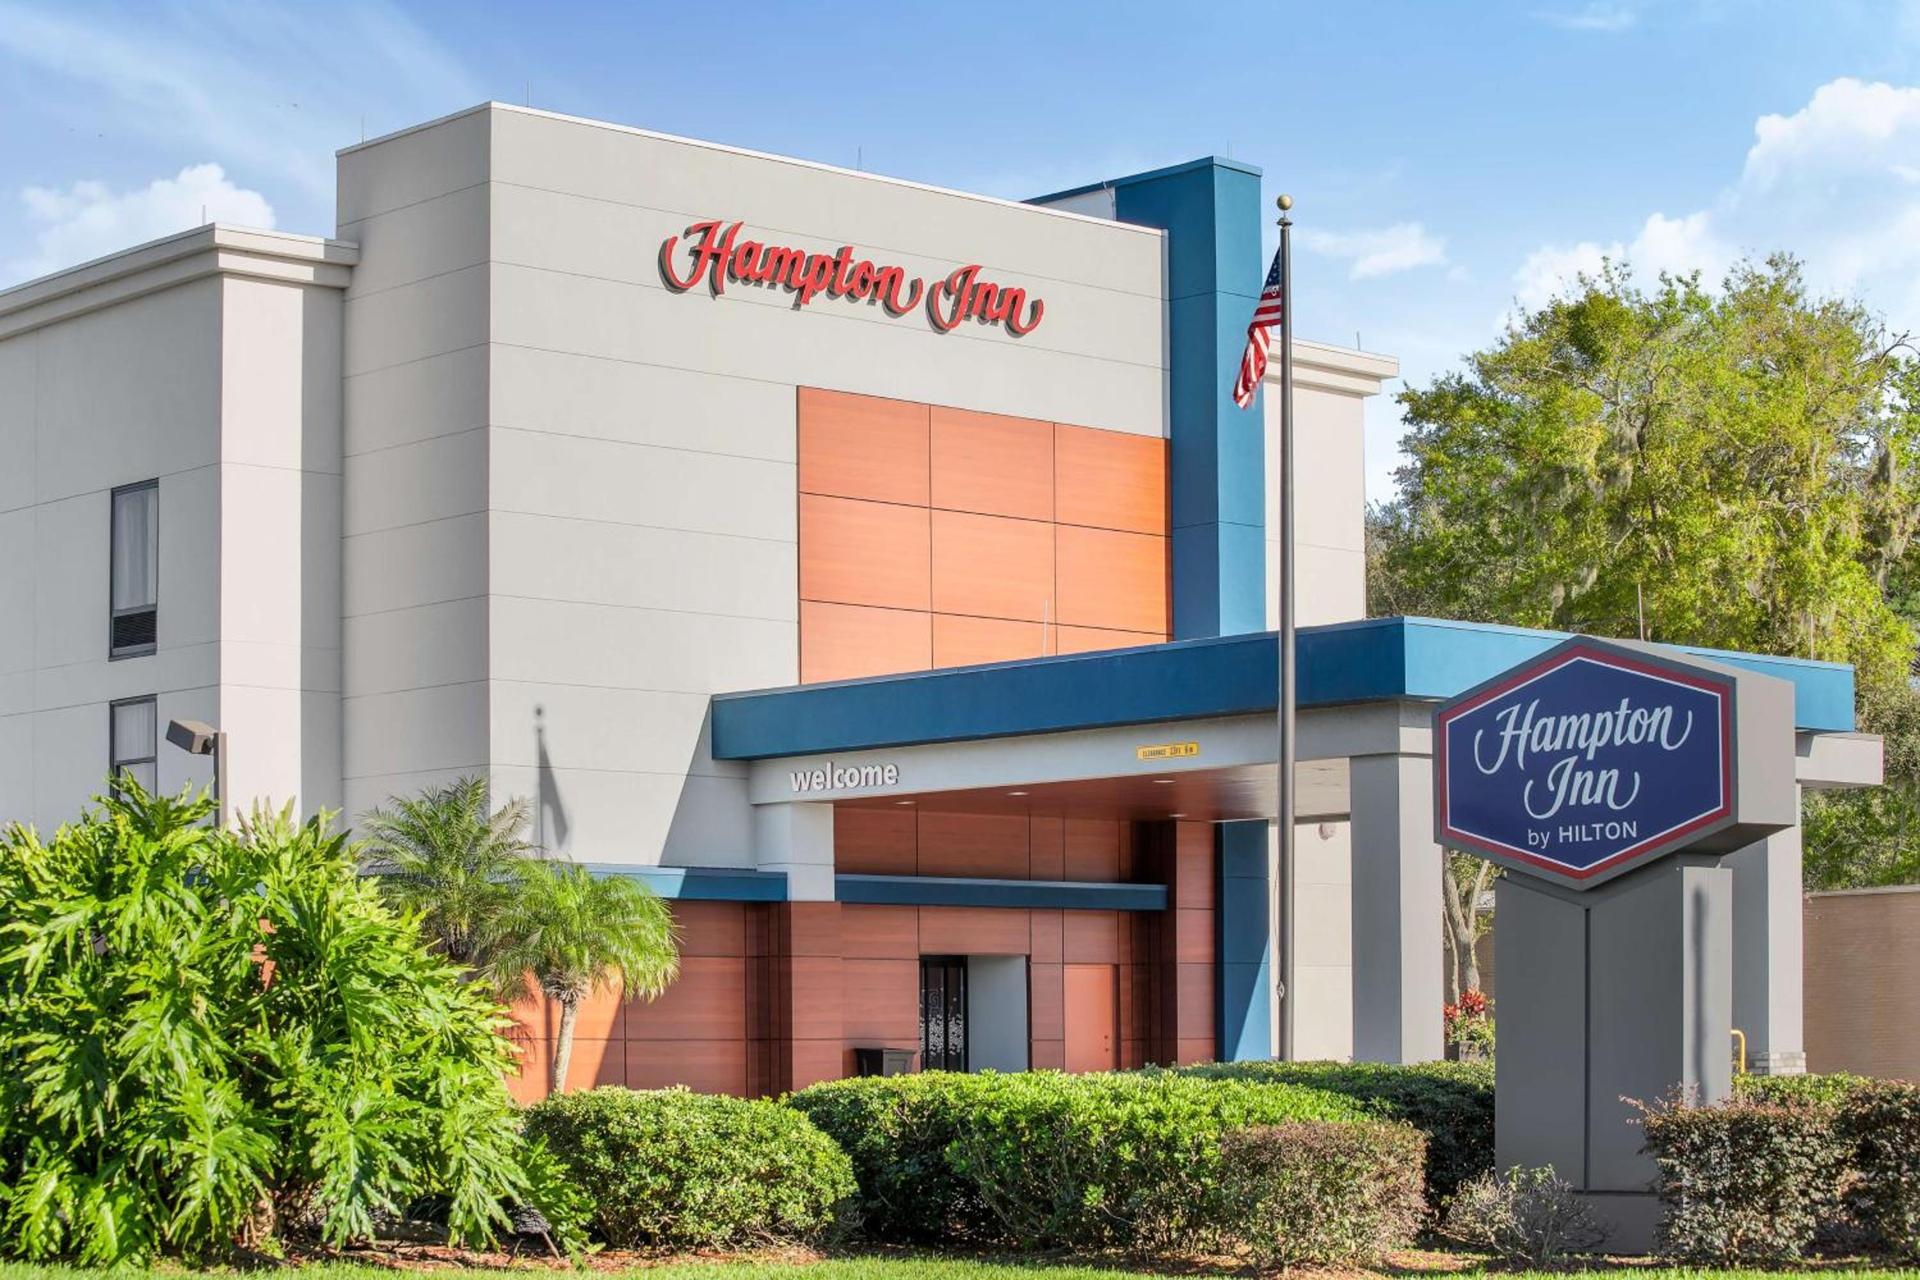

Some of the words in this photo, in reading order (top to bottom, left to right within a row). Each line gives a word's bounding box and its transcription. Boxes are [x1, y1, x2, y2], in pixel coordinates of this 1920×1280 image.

[659, 220, 923, 315] Hampton
[925, 264, 1043, 338] Inn
[1474, 697, 1693, 775] Hampton
[790, 761, 899, 792] welcome
[1524, 755, 1640, 819] Inn
[1527, 829, 1550, 849] by
[1558, 821, 1638, 843] HILTON
